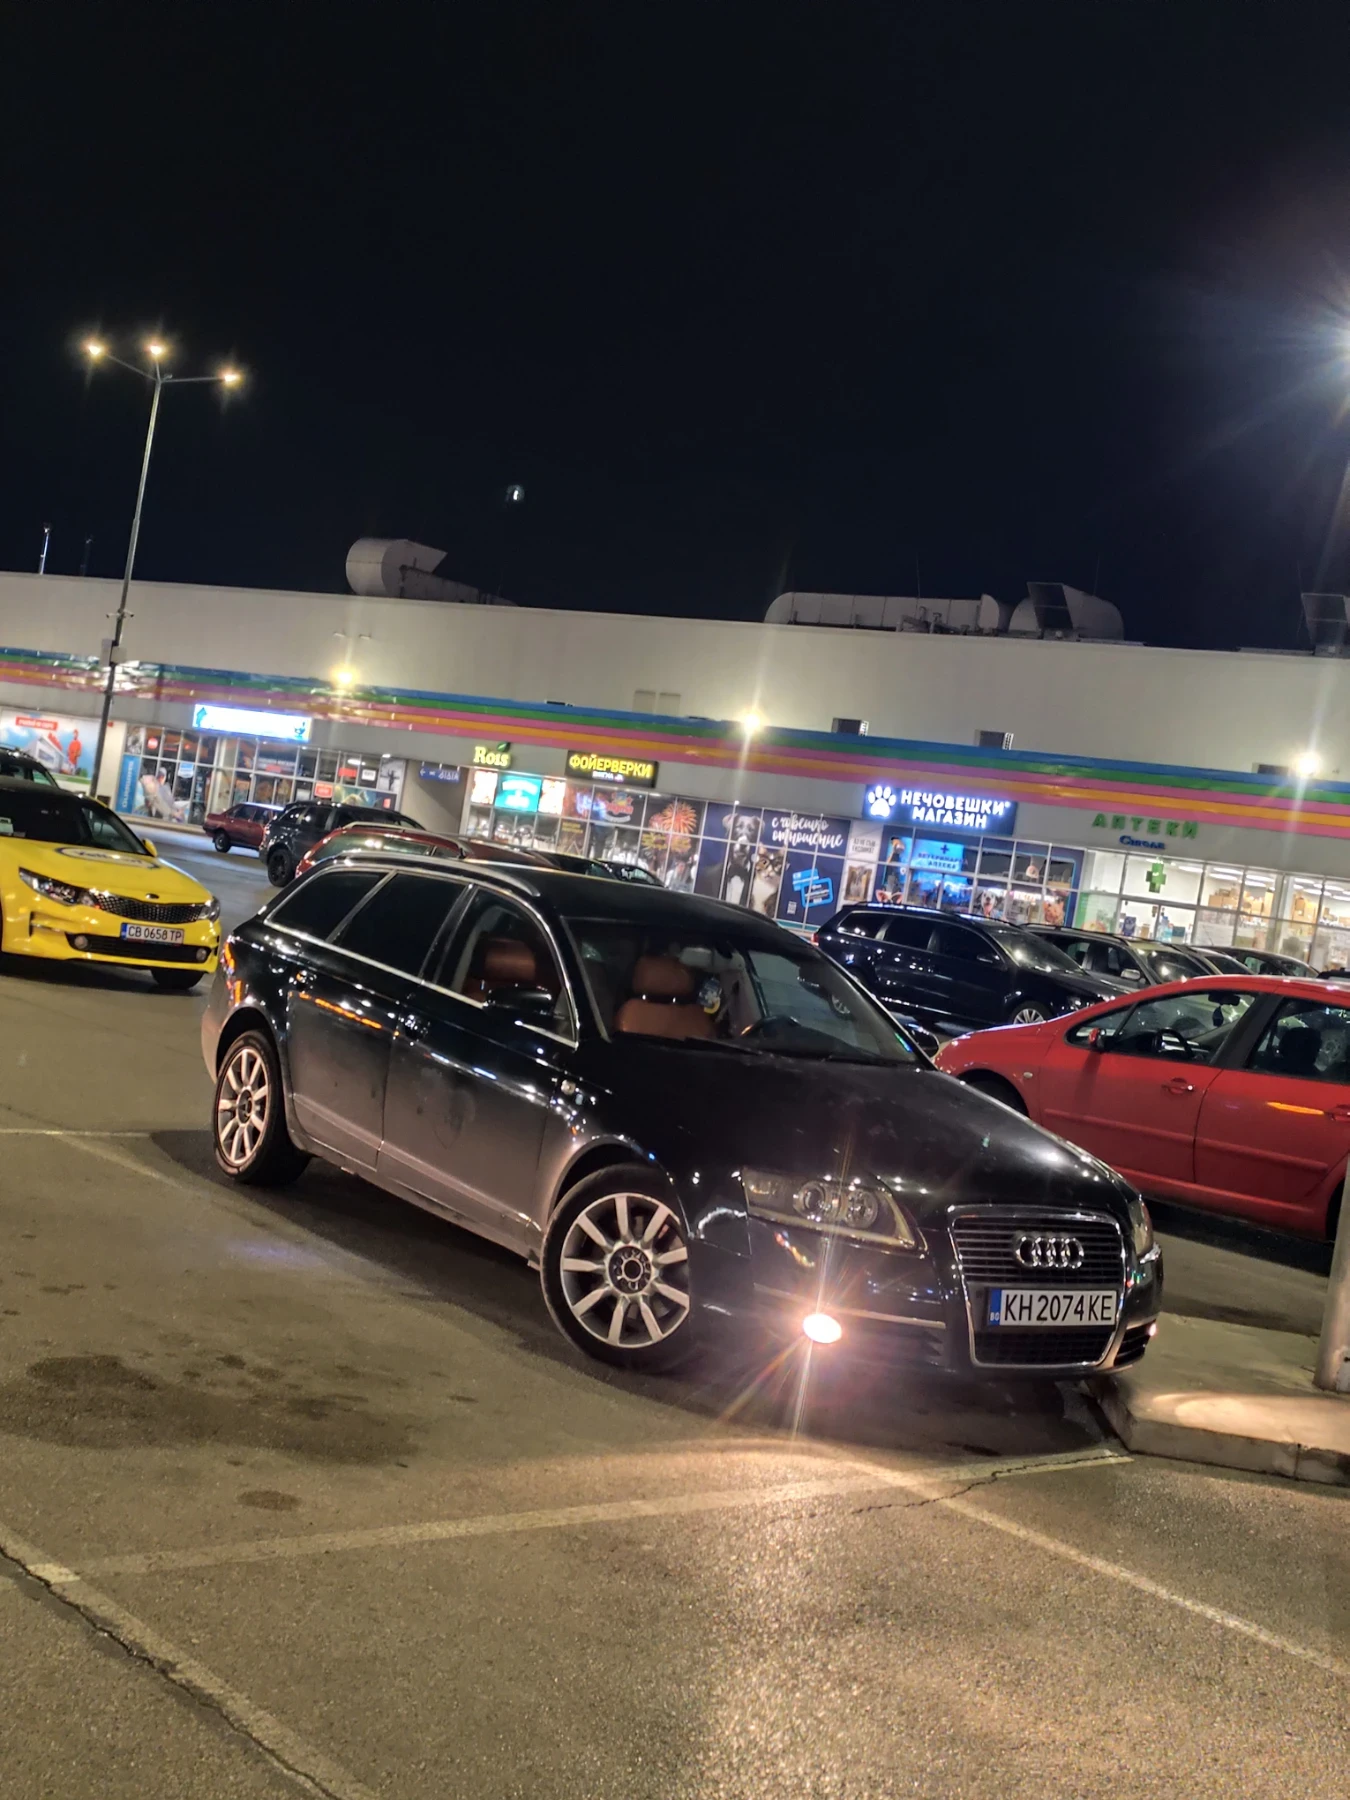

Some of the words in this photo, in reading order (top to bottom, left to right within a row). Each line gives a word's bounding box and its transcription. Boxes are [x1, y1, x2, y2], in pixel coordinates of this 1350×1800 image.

[472, 745, 510, 767] Rois
[568, 753, 654, 779] ФОЙЕРВЕРКИ
[912, 806, 987, 829] МАГАЗИН
[1092, 813, 1199, 840] АПТЕКИ
[772, 829, 844, 849] отношение
[927, 860, 957, 870] АПТЕКА
[144, 928, 168, 940] 0658
